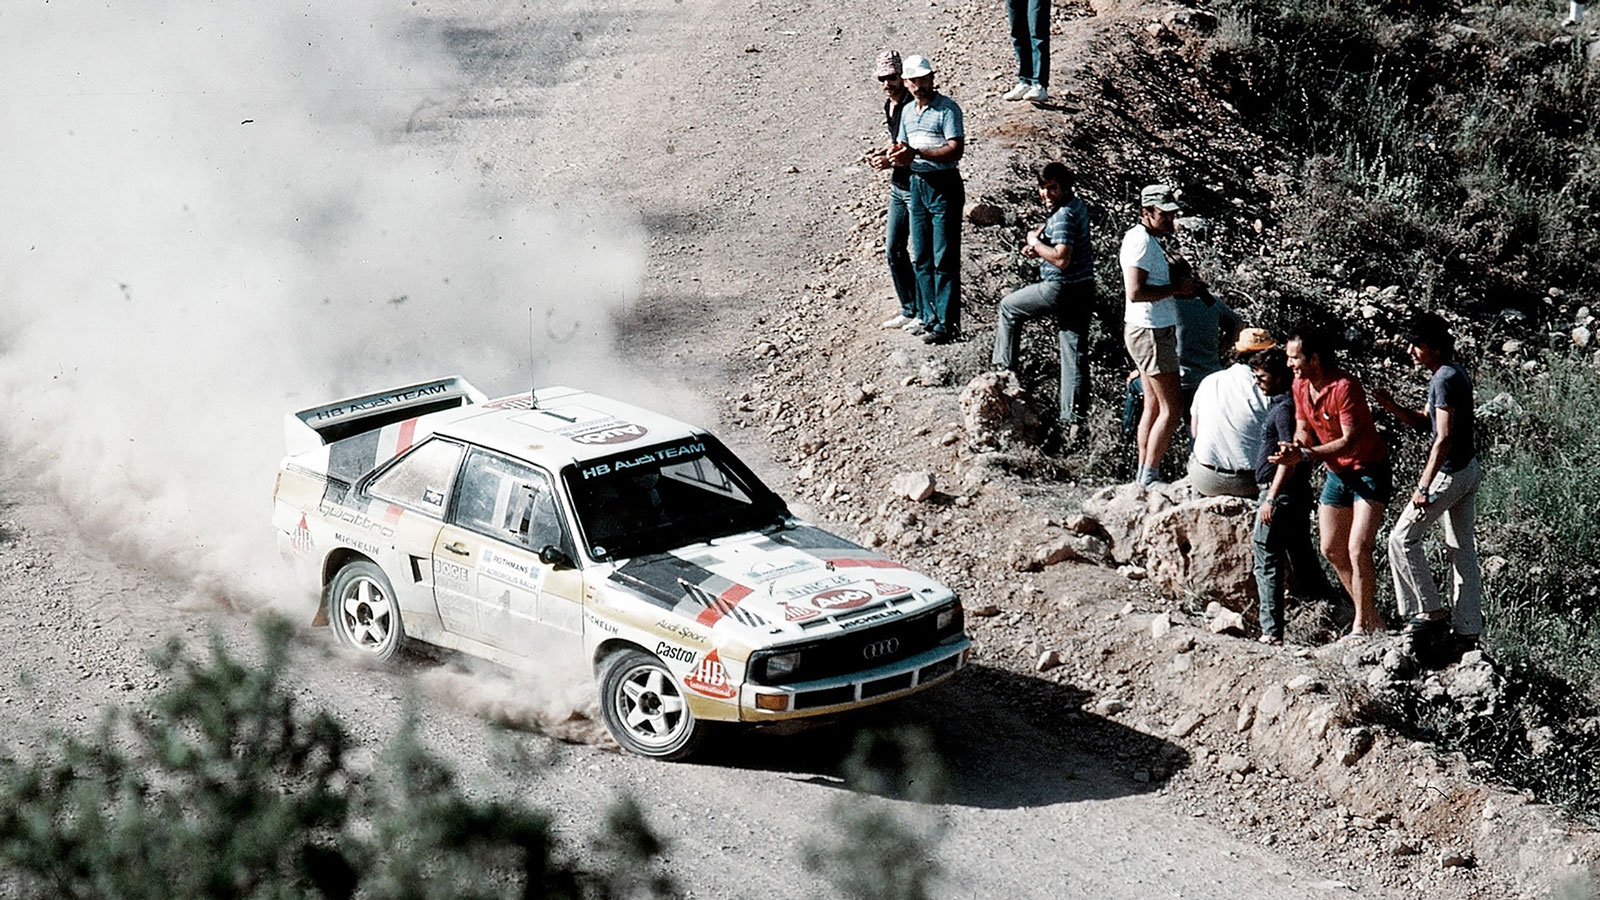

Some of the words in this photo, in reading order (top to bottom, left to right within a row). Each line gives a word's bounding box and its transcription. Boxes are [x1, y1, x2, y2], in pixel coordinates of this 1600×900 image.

[316, 407, 345, 420] HB
[391, 384, 447, 402] TEAM
[582, 465, 611, 480] HB
[655, 442, 706, 460] TEAM
[319, 504, 394, 537] quattro
[335, 532, 380, 555] MICHELIN
[493, 555, 529, 574] ROTHMANS
[584, 612, 619, 635] CHELIN
[656, 619, 679, 633] Audi
[678, 626, 708, 644] Sport
[839, 609, 903, 630] MICHELIN
[655, 641, 697, 664] Castrol
[694, 659, 727, 686] HB
